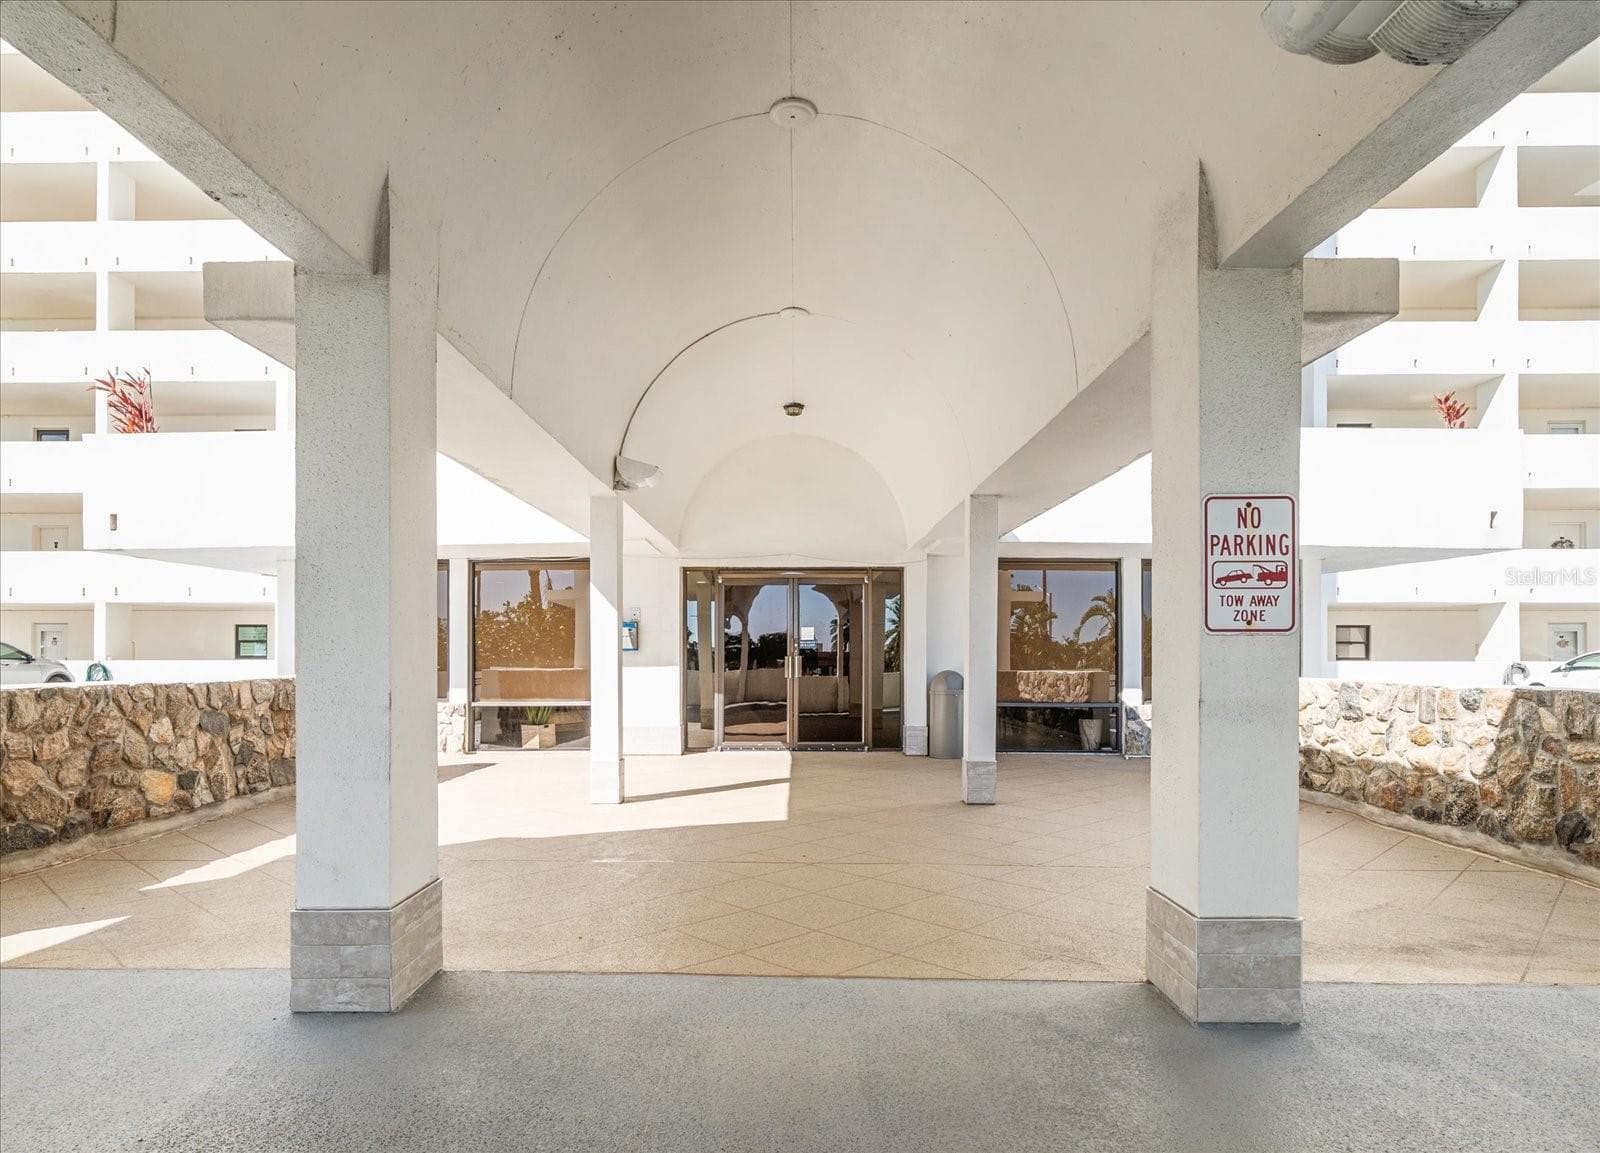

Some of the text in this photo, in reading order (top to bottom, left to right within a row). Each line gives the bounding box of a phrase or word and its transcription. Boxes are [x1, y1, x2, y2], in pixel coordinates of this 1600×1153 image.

[1237, 507, 1261, 529] NO
[1210, 534, 1290, 556] PARKING
[1219, 595, 1280, 607] TOW AWAY
[1233, 609, 1266, 622] ZONE
